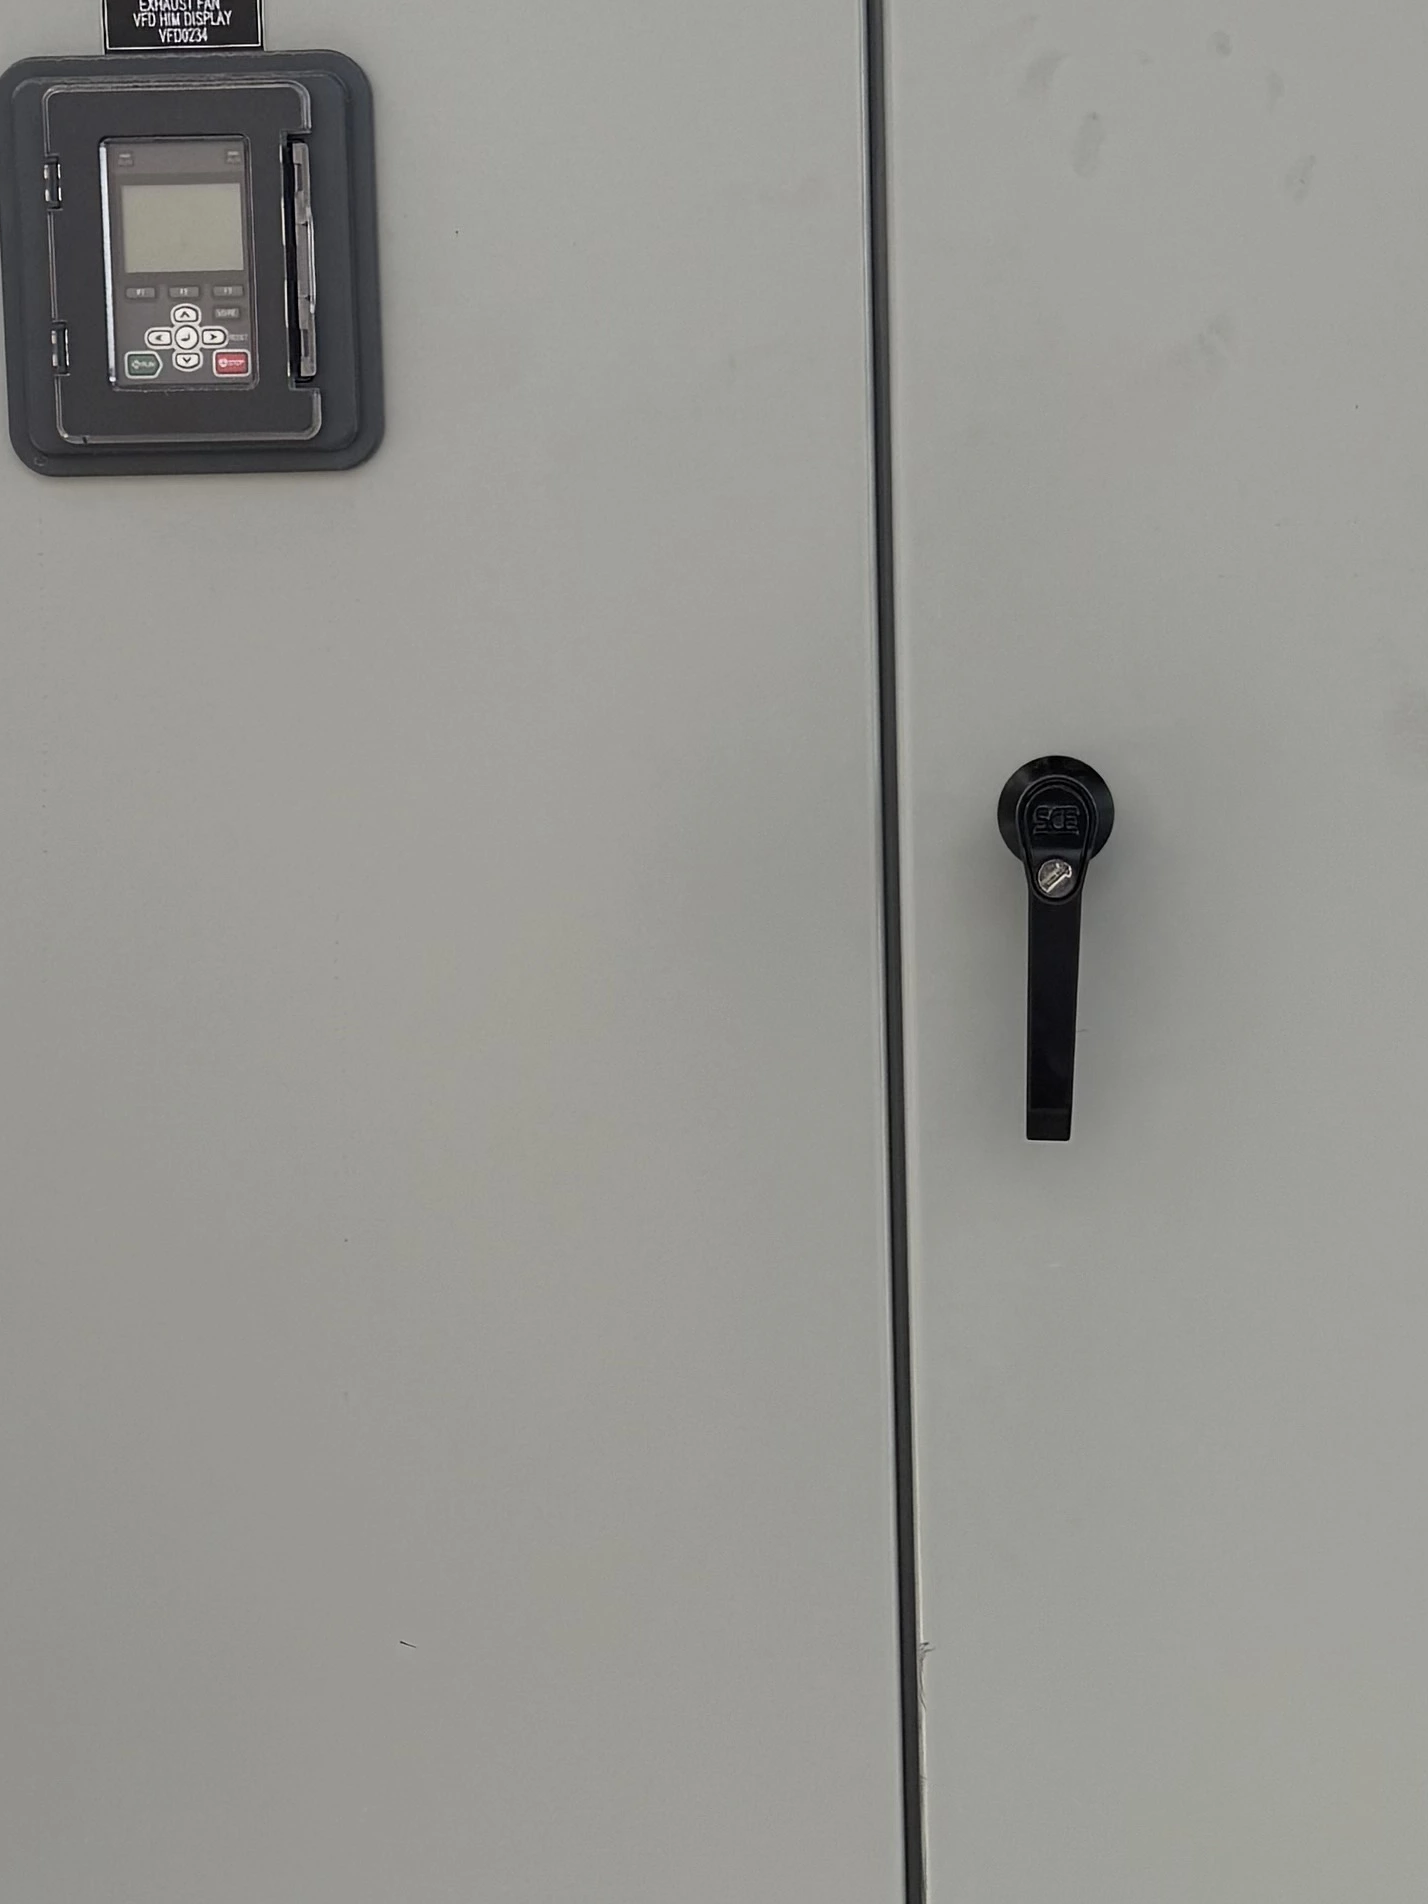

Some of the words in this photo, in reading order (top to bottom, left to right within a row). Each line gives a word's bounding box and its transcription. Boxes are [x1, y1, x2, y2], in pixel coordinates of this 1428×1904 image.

[133, 13, 156, 28] VFD
[160, 12, 180, 27] HIM
[184, 10, 232, 27] DISPLAY
[159, 27, 208, 43] VFD0234
